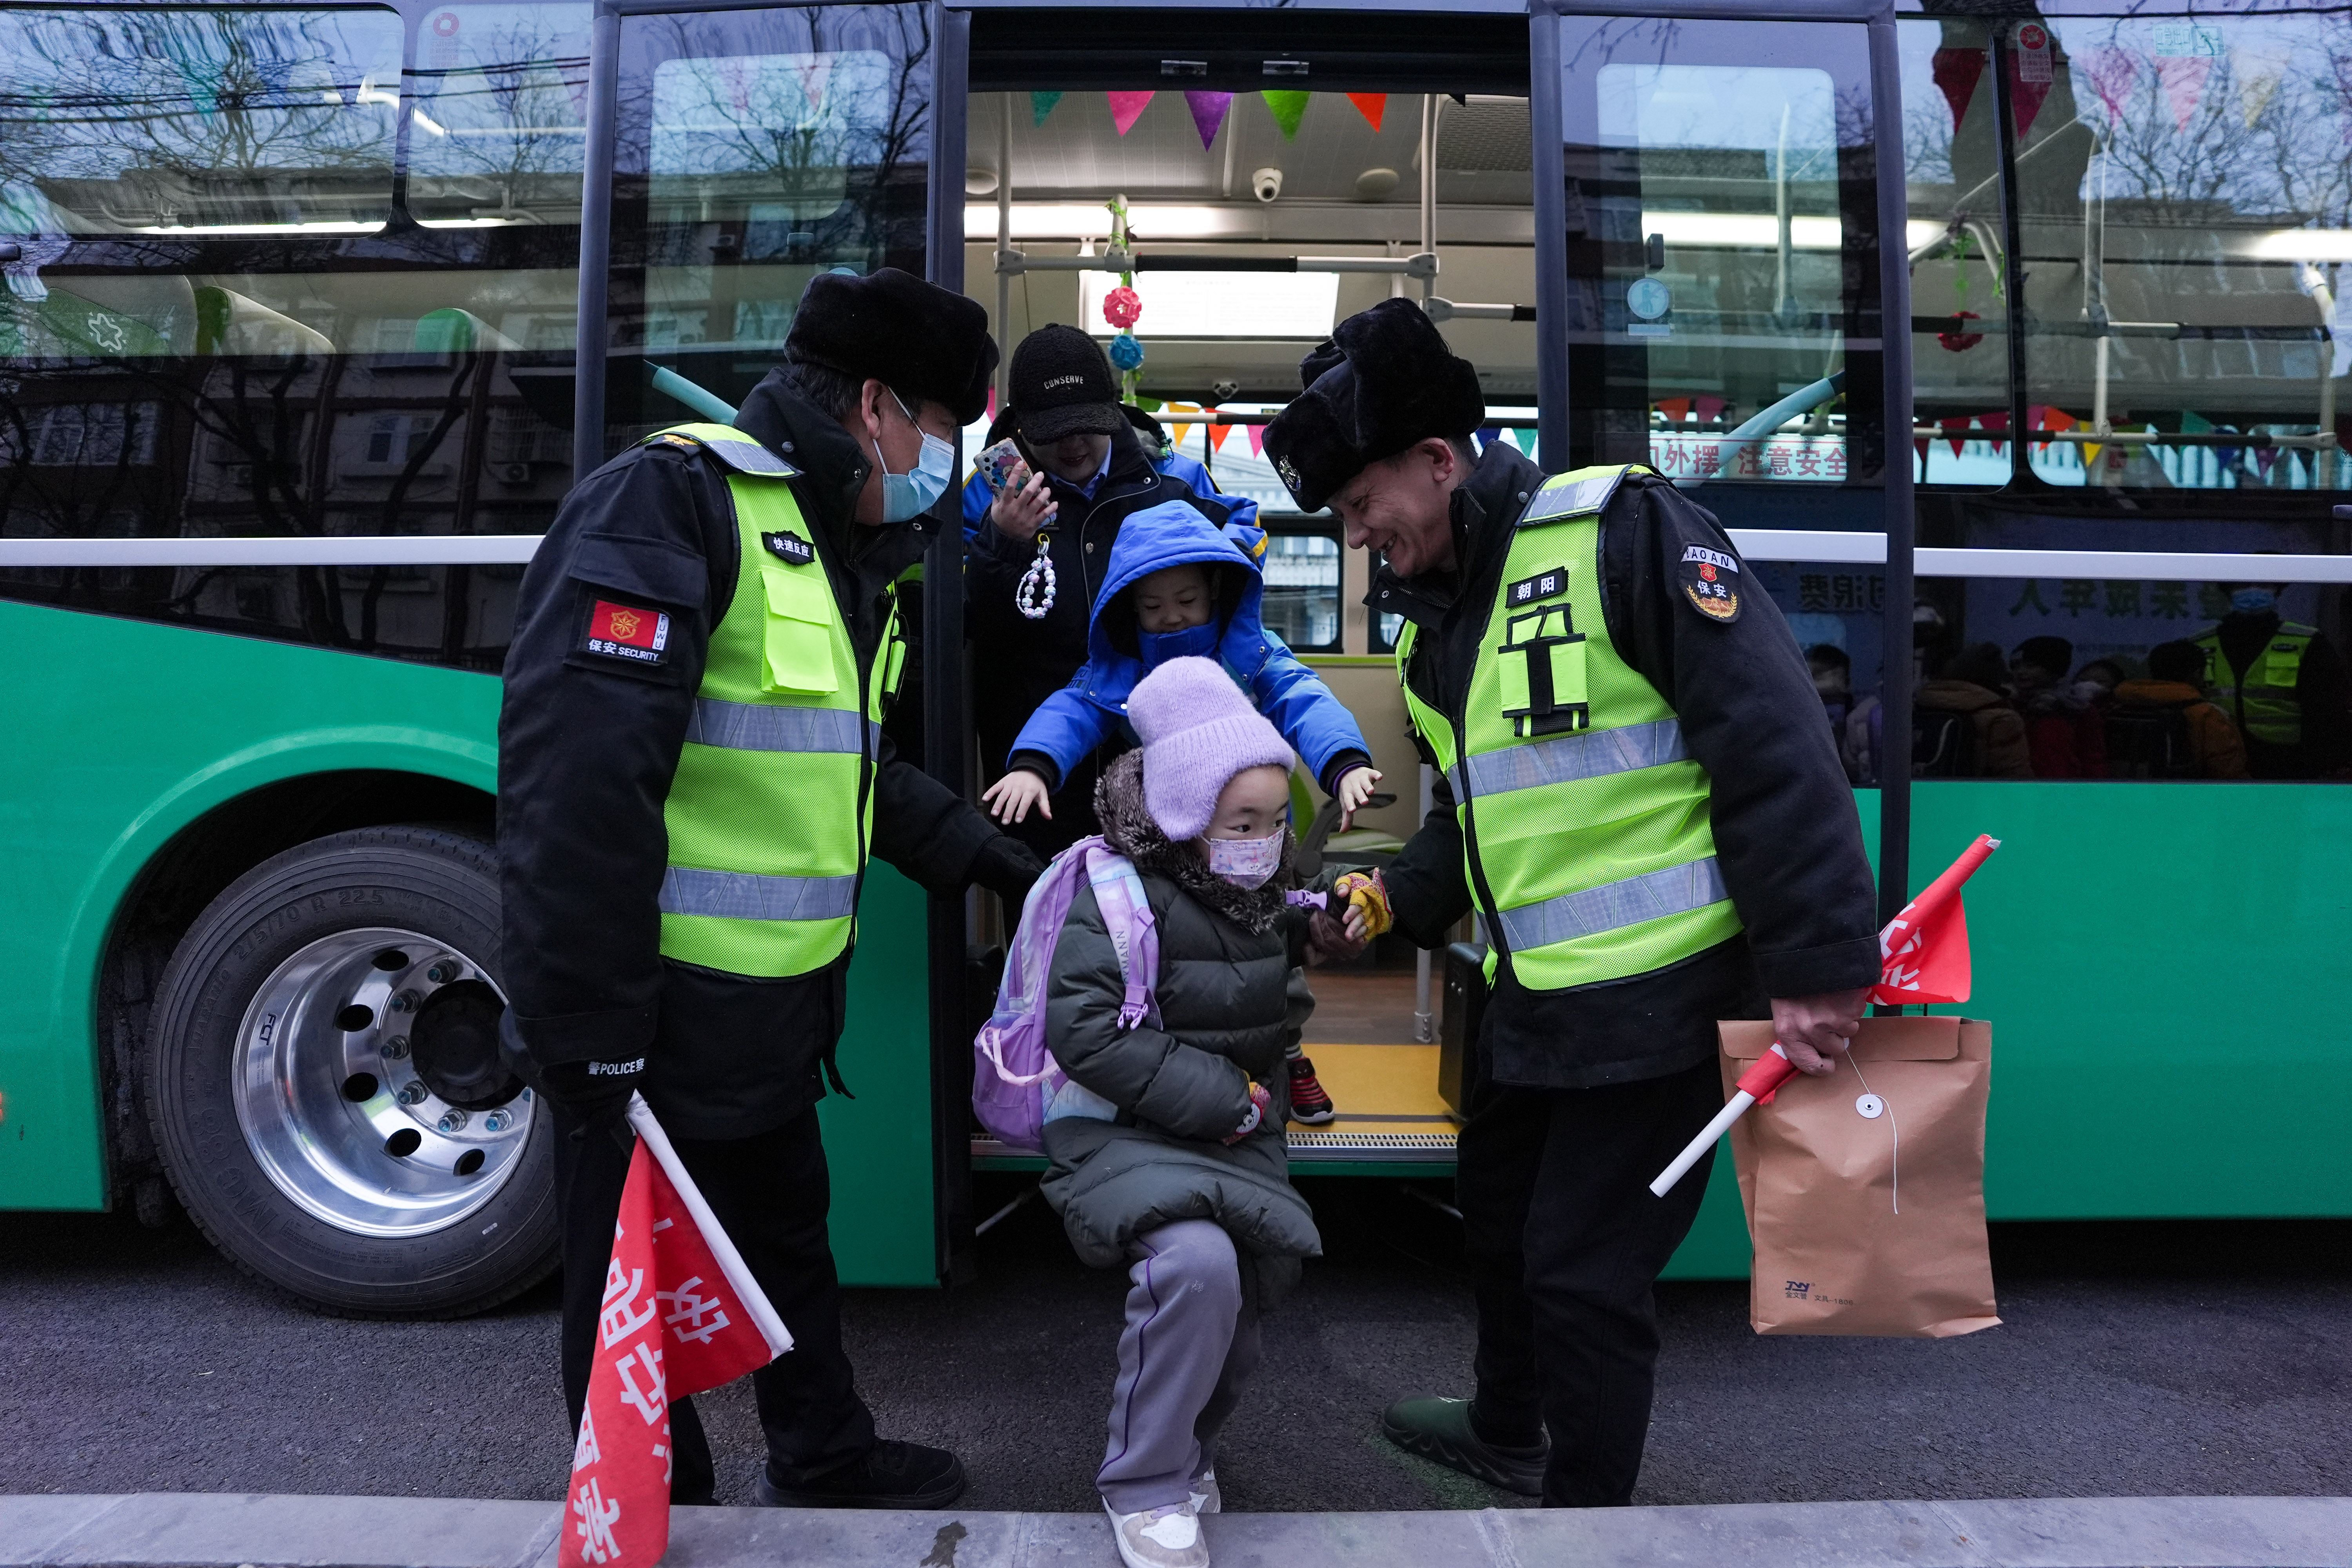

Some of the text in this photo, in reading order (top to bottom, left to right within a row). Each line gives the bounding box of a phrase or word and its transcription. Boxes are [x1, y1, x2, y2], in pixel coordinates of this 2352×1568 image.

[1044, 375, 1083, 389] CONSERVE
[1739, 445, 1847, 476] 注意安全
[773, 537, 809, 557] 快速反应
[1686, 548, 1729, 567] BAOAN
[1517, 575, 1555, 600] 朝阳
[1697, 580, 1727, 598] 保安
[655, 615, 666, 648] FUWU
[589, 639, 617, 654] 保安
[618, 647, 659, 662] SECURITY
